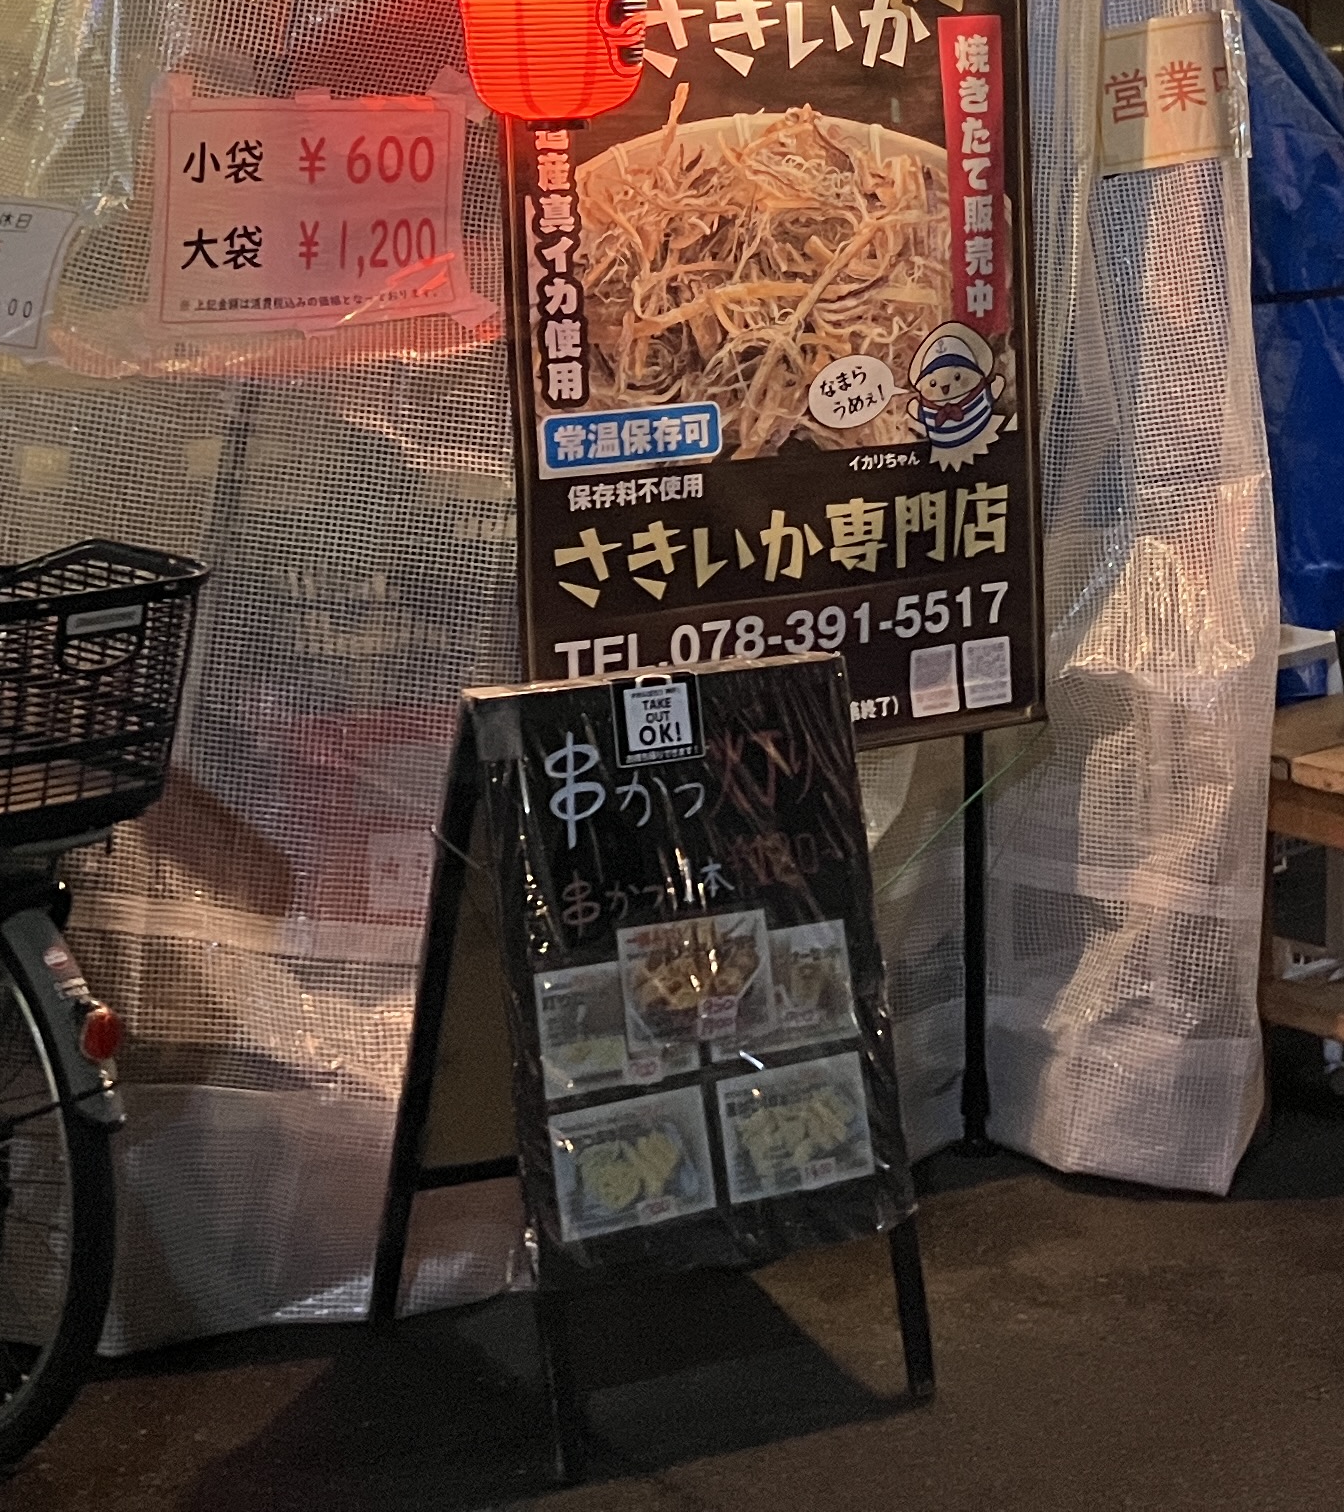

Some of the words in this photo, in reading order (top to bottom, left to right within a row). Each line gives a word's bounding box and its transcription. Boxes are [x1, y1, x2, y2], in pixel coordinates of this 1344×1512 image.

[182, 139, 264, 184] 小袋
[953, 32, 994, 319] 焼きたて販売中
[180, 225, 264, 270] 大袋
[819, 365, 867, 400] なまら
[553, 412, 711, 462] 常温保存可
[849, 453, 921, 472] イカリちゃん
[567, 472, 704, 512] 保存料不使用
[553, 481, 1010, 609] さきいか専門店
[641, 696, 672, 710] TAKE
[645, 710, 671, 724] OUT
[639, 721, 682, 746] OK!
[544, 731, 705, 849] 串かつ
